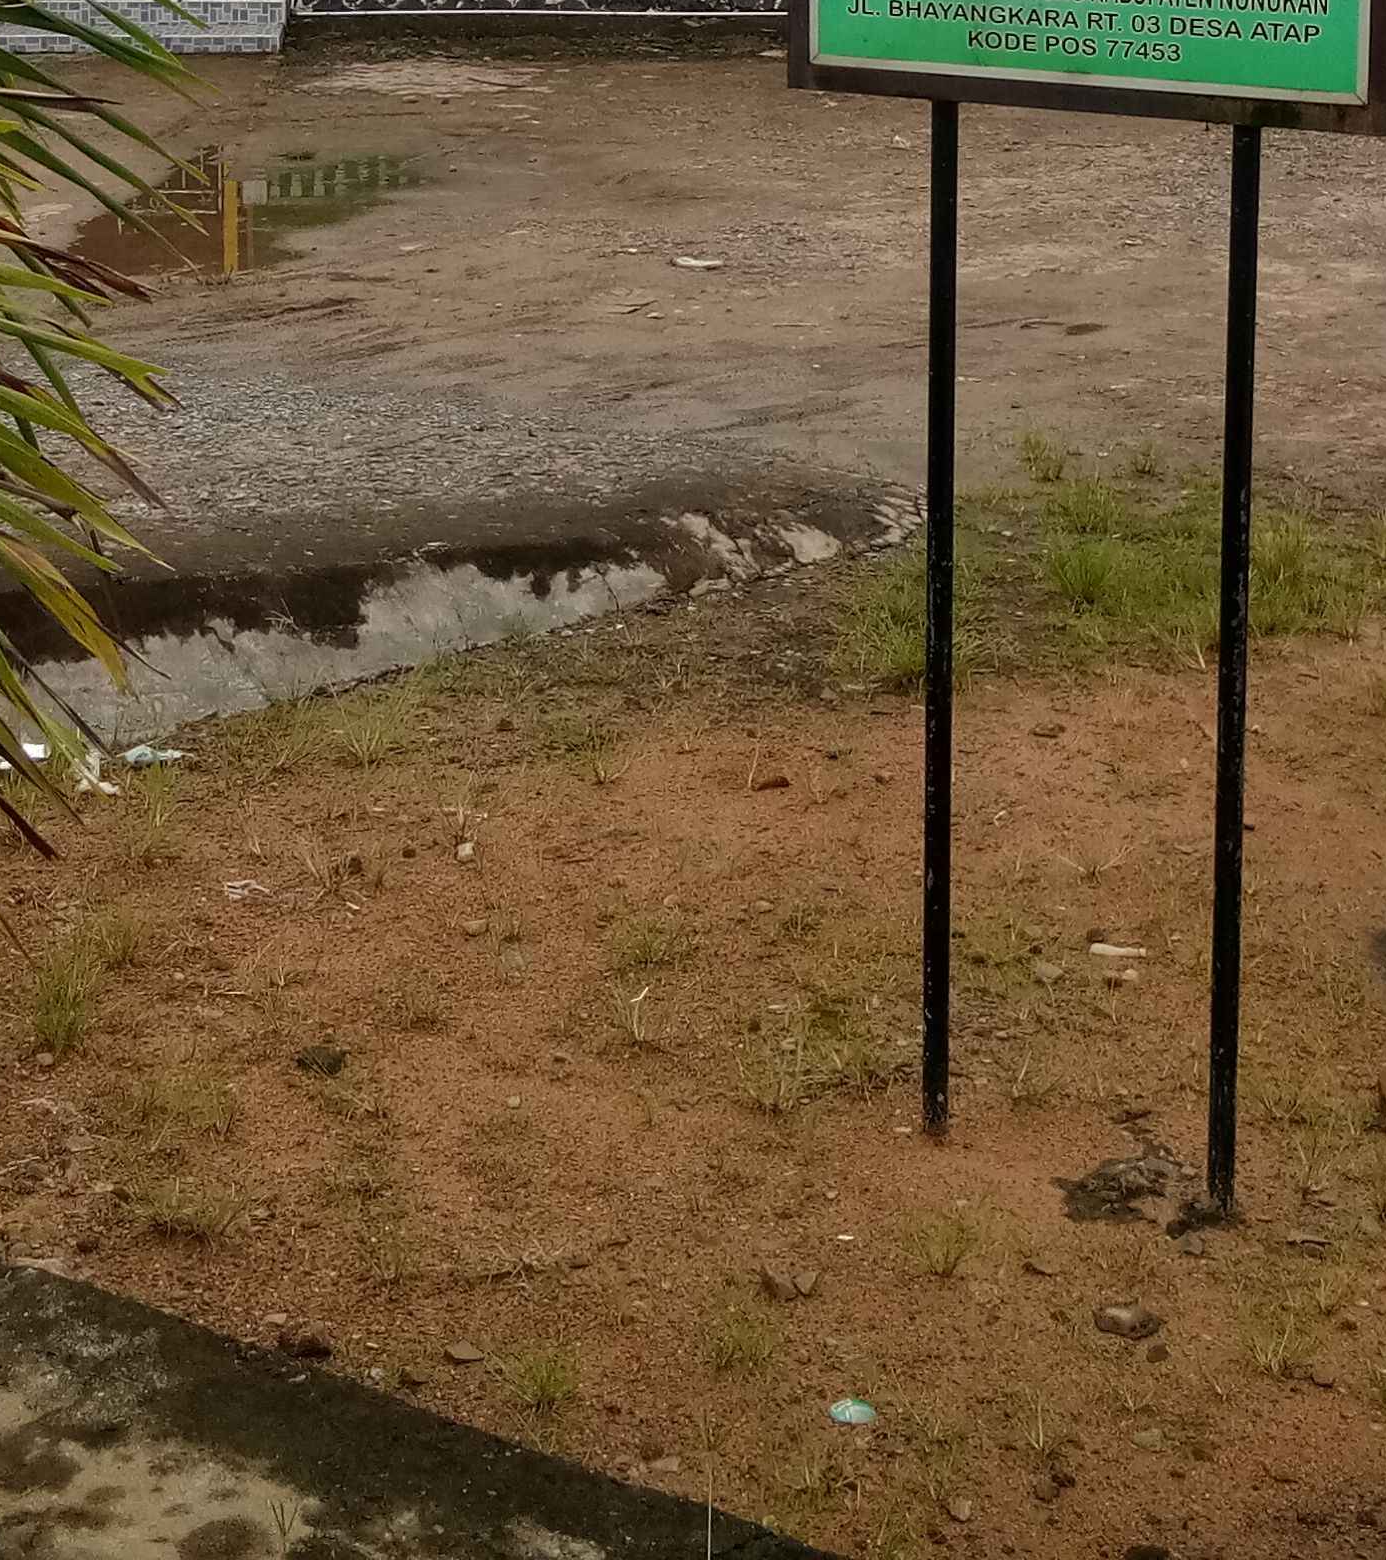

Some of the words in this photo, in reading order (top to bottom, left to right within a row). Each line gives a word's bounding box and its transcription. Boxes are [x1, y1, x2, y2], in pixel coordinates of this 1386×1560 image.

[888, 0, 1079, 29] BHAYANGKARA
[1087, 12, 1123, 32] RT.
[1131, 14, 1161, 34] 03
[1169, 16, 1243, 40] DESA
[1250, 21, 1321, 44] ATAP
[967, 30, 1037, 53] KODE
[1045, 35, 1097, 57] POS
[1105, 39, 1182, 63] 77453
